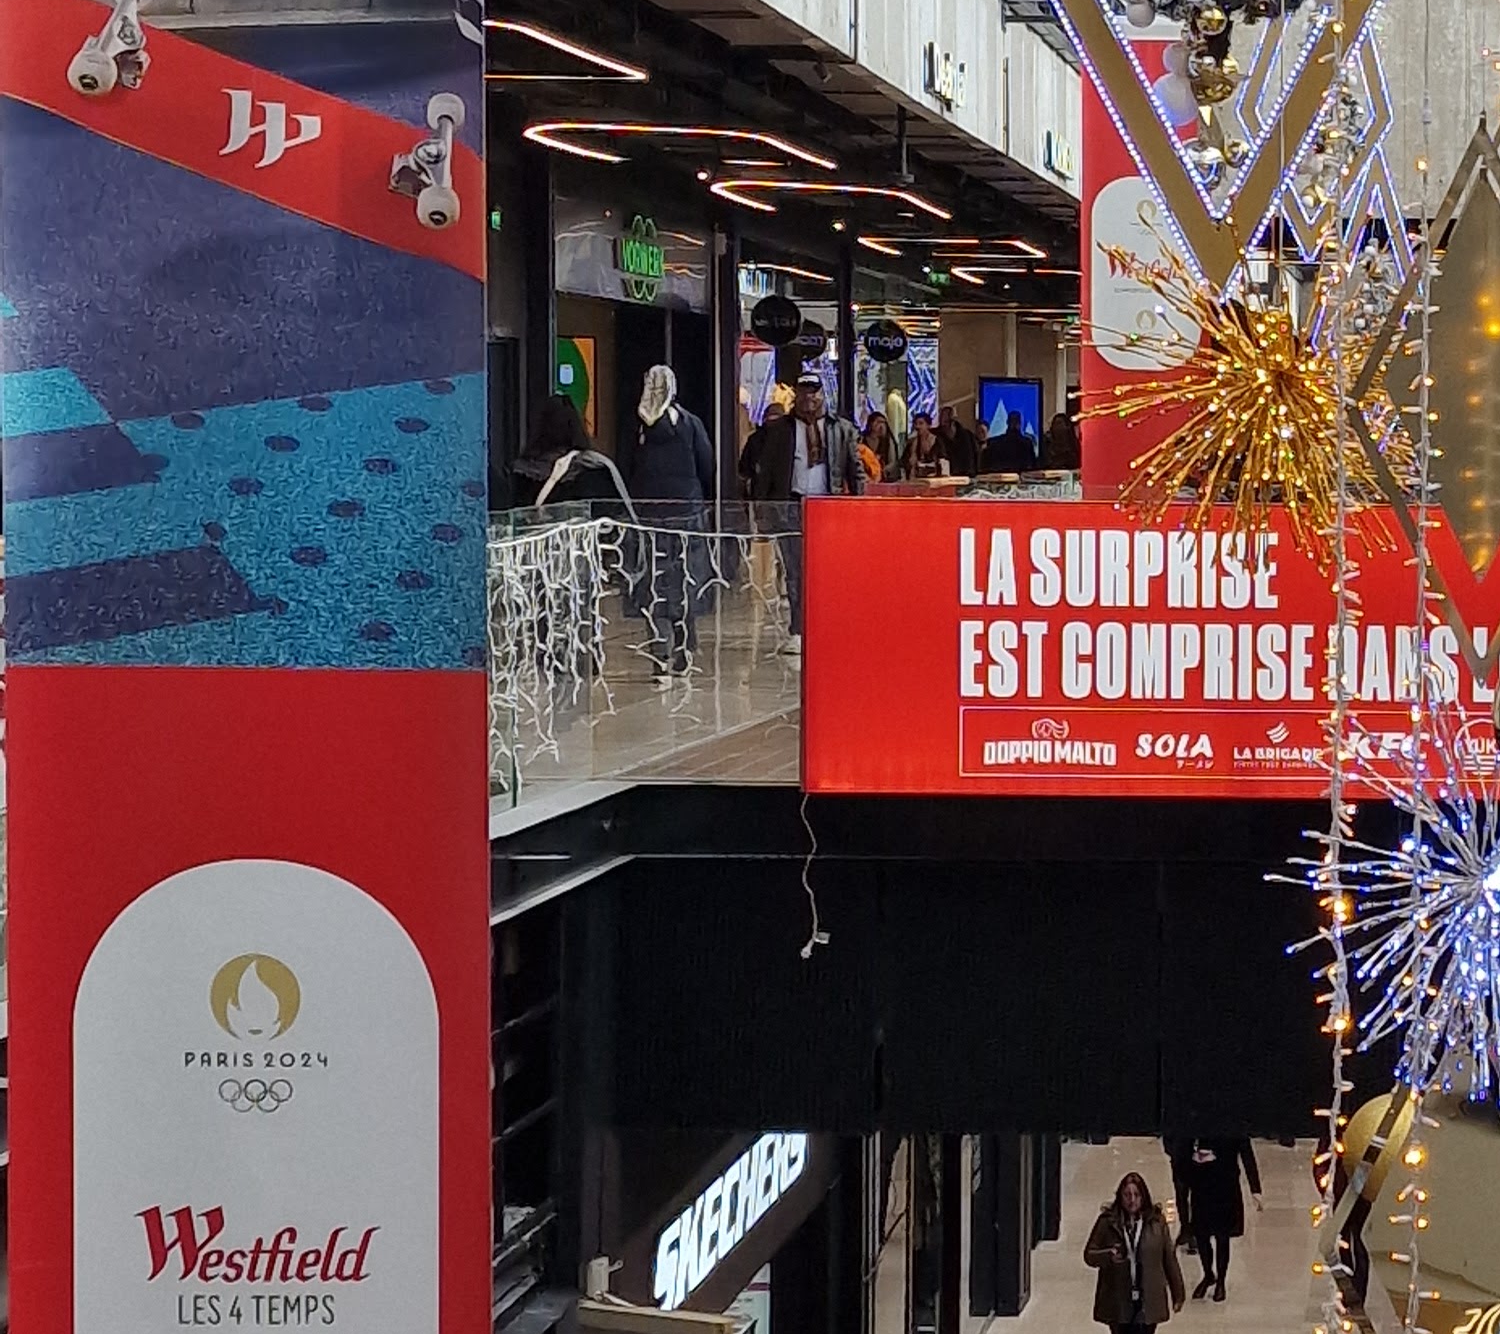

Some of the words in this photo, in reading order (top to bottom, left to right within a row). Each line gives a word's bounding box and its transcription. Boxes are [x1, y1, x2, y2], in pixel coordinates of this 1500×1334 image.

[960, 527, 1018, 606] LA
[1029, 528, 1279, 610] SURPRISE
[960, 620, 1049, 698] EST
[1061, 621, 1315, 701] COMPRISE
[1327, 624, 1460, 705] DANS
[984, 740, 1051, 766] DOPPIO
[1054, 741, 1117, 766] MALTO
[1135, 733, 1214, 759] SOLA
[1233, 747, 1252, 760] LA
[1254, 747, 1326, 762] BRIGADE
[1348, 732, 1430, 760] KFC
[184, 1052, 254, 1069] PARIS
[264, 1052, 329, 1068] 2024
[134, 1204, 381, 1285] Westfield
[178, 1294, 222, 1326] LES
[229, 1295, 243, 1325] 4
[251, 1294, 335, 1325] TEMPS
